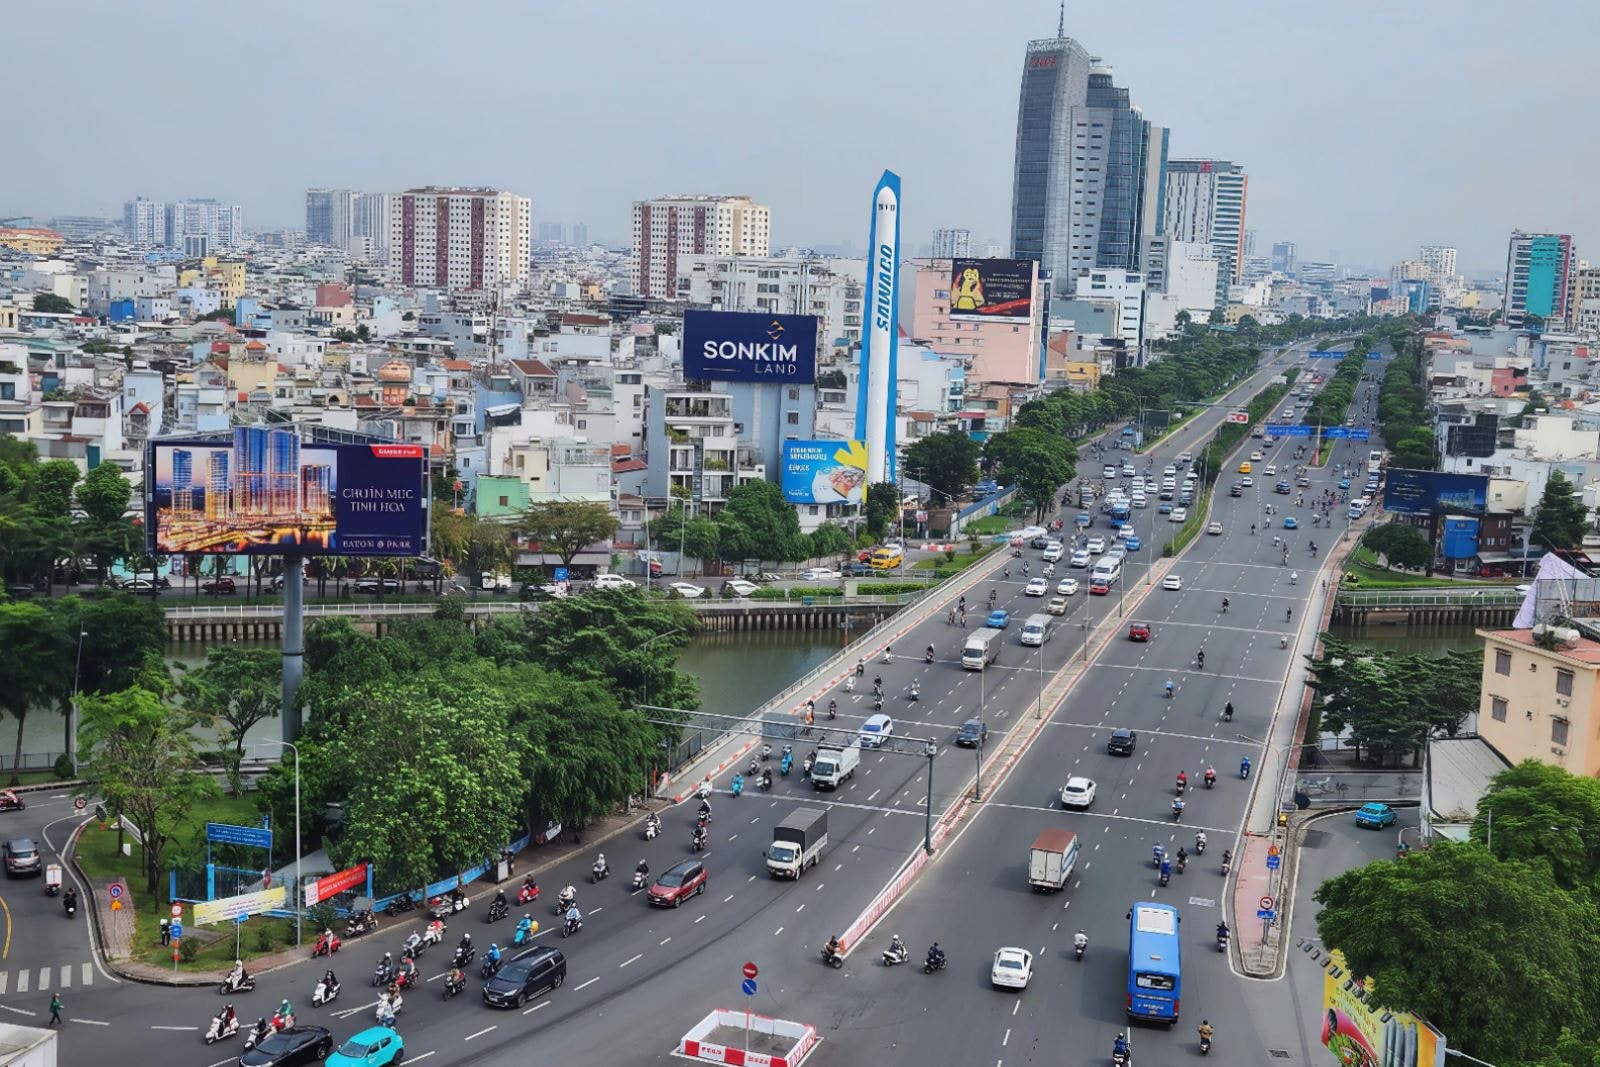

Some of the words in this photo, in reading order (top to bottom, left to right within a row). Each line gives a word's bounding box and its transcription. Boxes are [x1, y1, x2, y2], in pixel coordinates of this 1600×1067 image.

[877, 244, 893, 332] SAWACO
[703, 340, 797, 362] SONKIM
[755, 363, 797, 375] LAND
